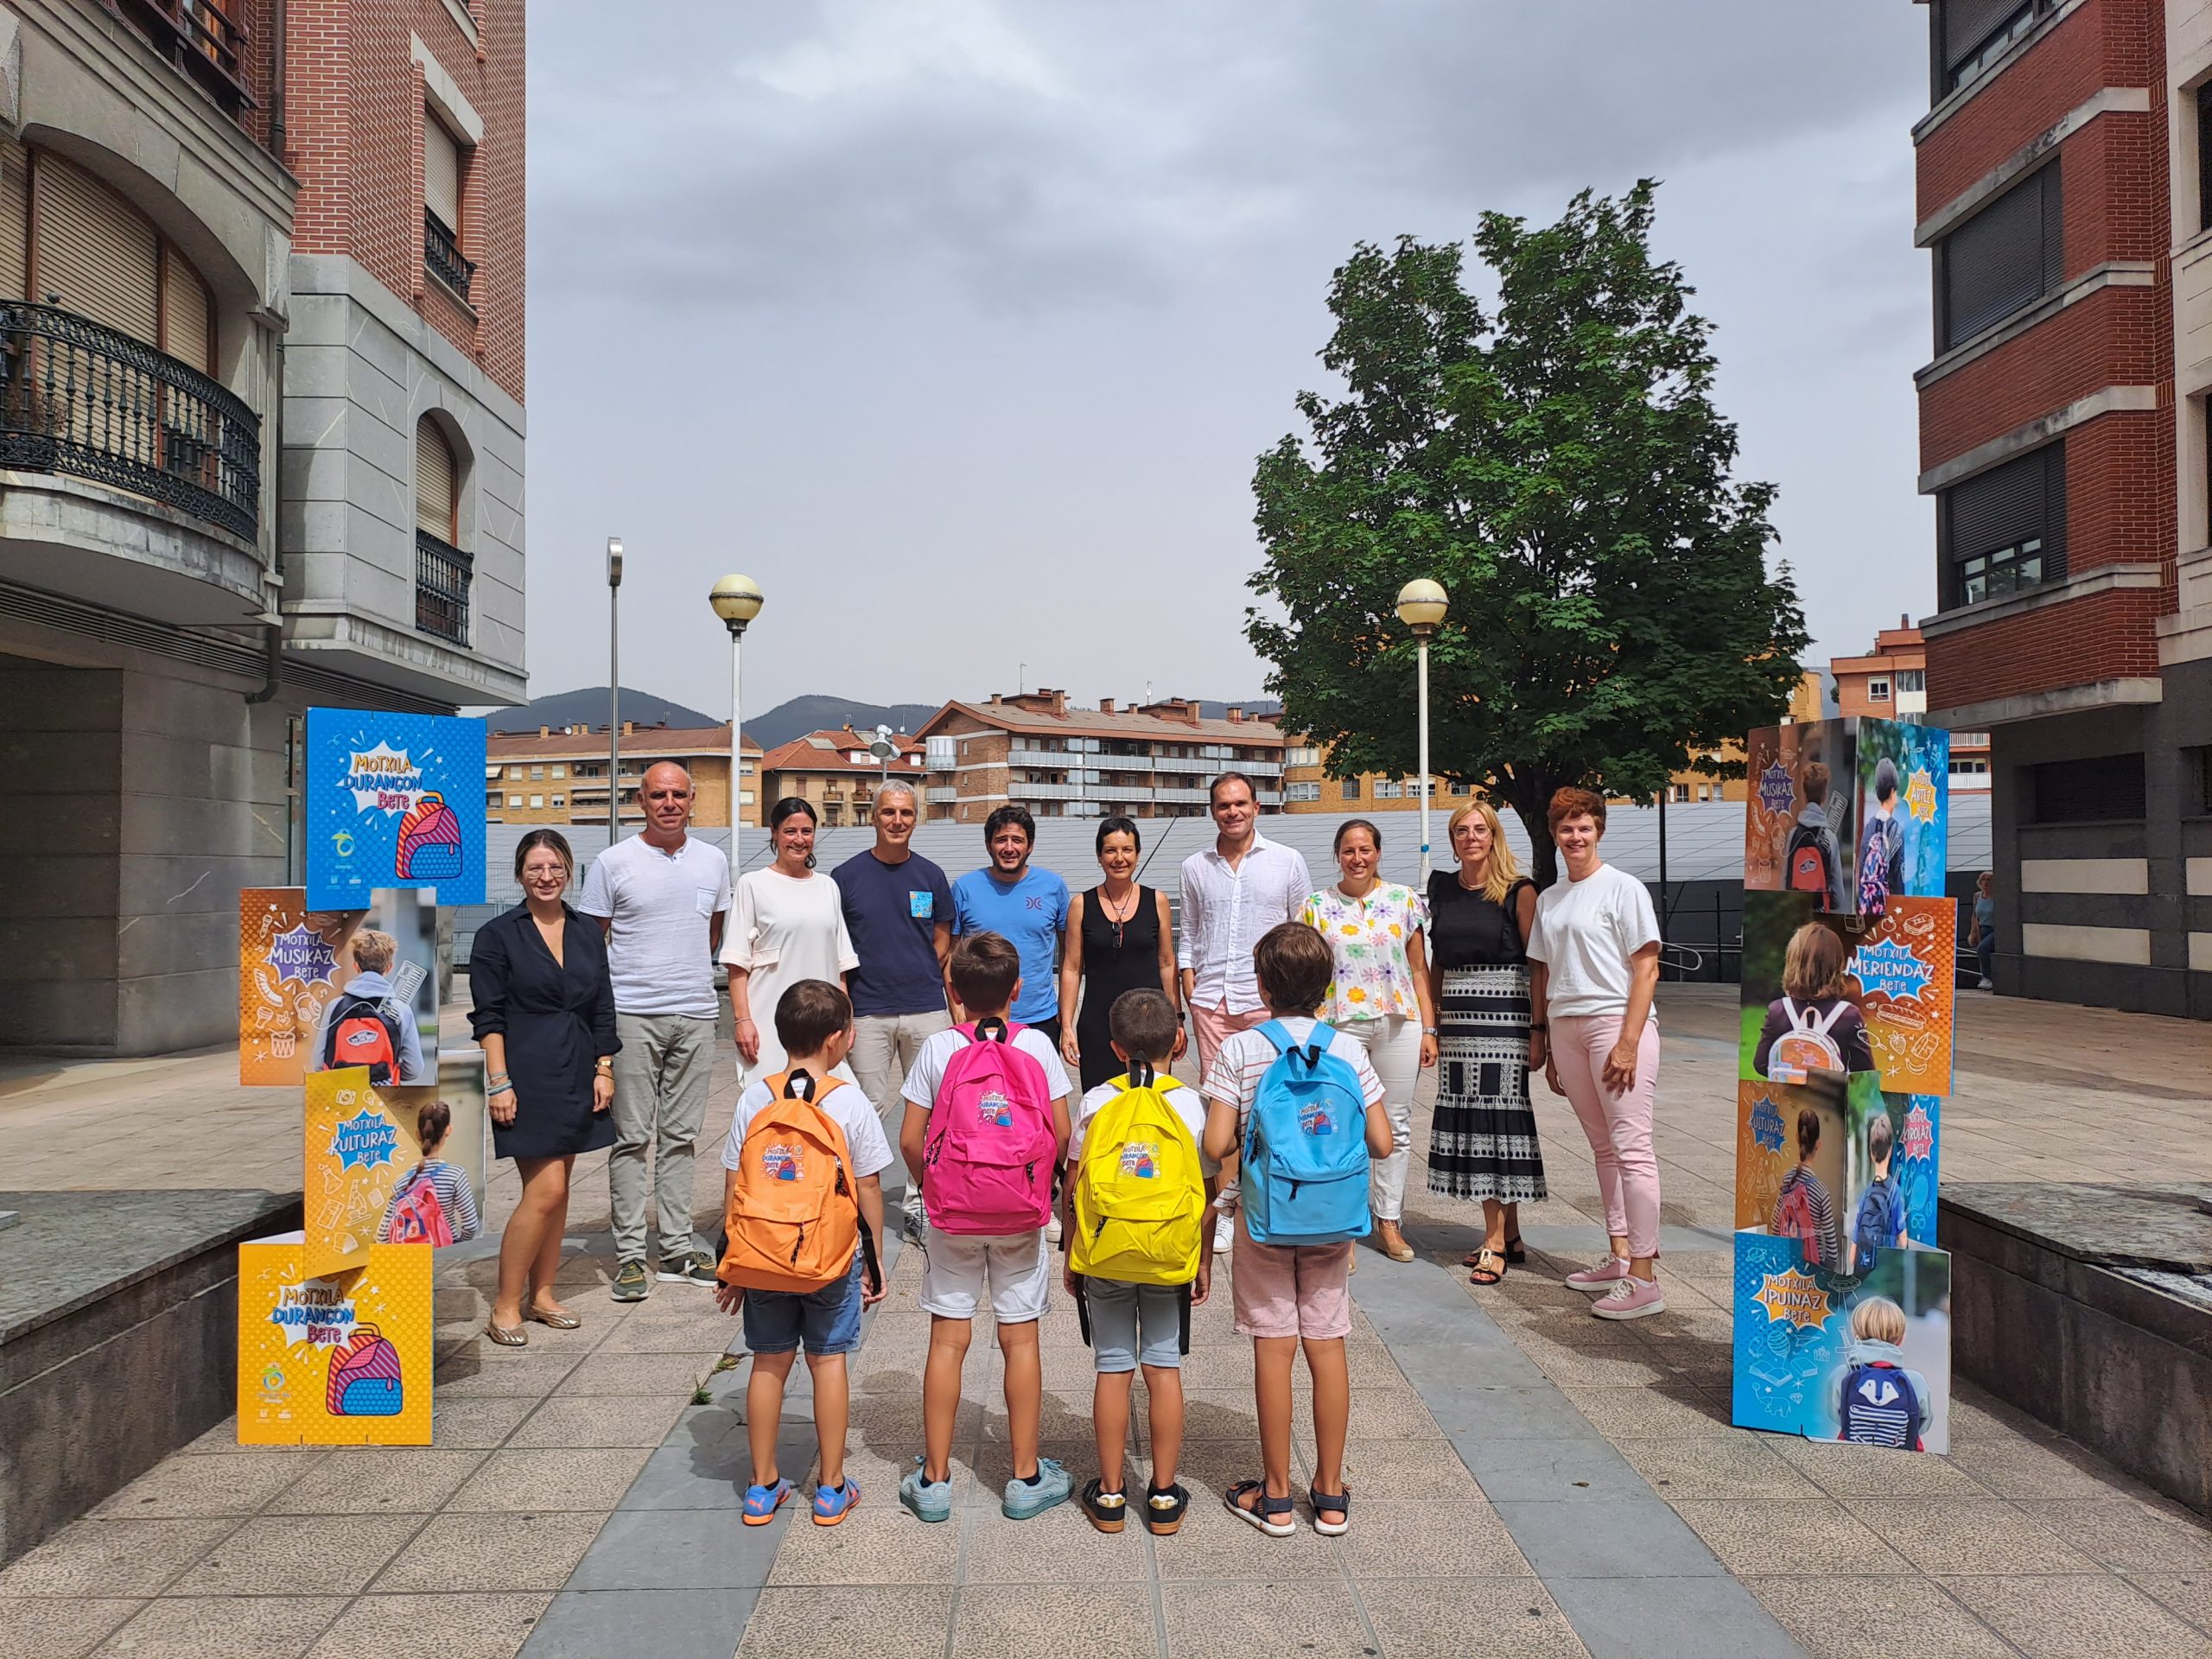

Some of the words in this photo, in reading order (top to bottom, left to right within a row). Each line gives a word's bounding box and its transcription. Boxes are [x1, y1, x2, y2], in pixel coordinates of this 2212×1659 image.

[353, 754, 413, 773] MOTXILA
[280, 933, 324, 947] MOTXILA
[269, 947, 333, 966] MUSIKAZ
[1864, 944, 1913, 960] MOTXILA
[1845, 957, 1935, 980] MERIENDAZ
[342, 1116, 385, 1134] MOTXILA
[330, 1128, 397, 1156] KULTURAZ
[1767, 1274, 1815, 1291] MOTXILA
[283, 1287, 345, 1306] MOTXILA
[1764, 1288, 1821, 1310] IPUINAZ
